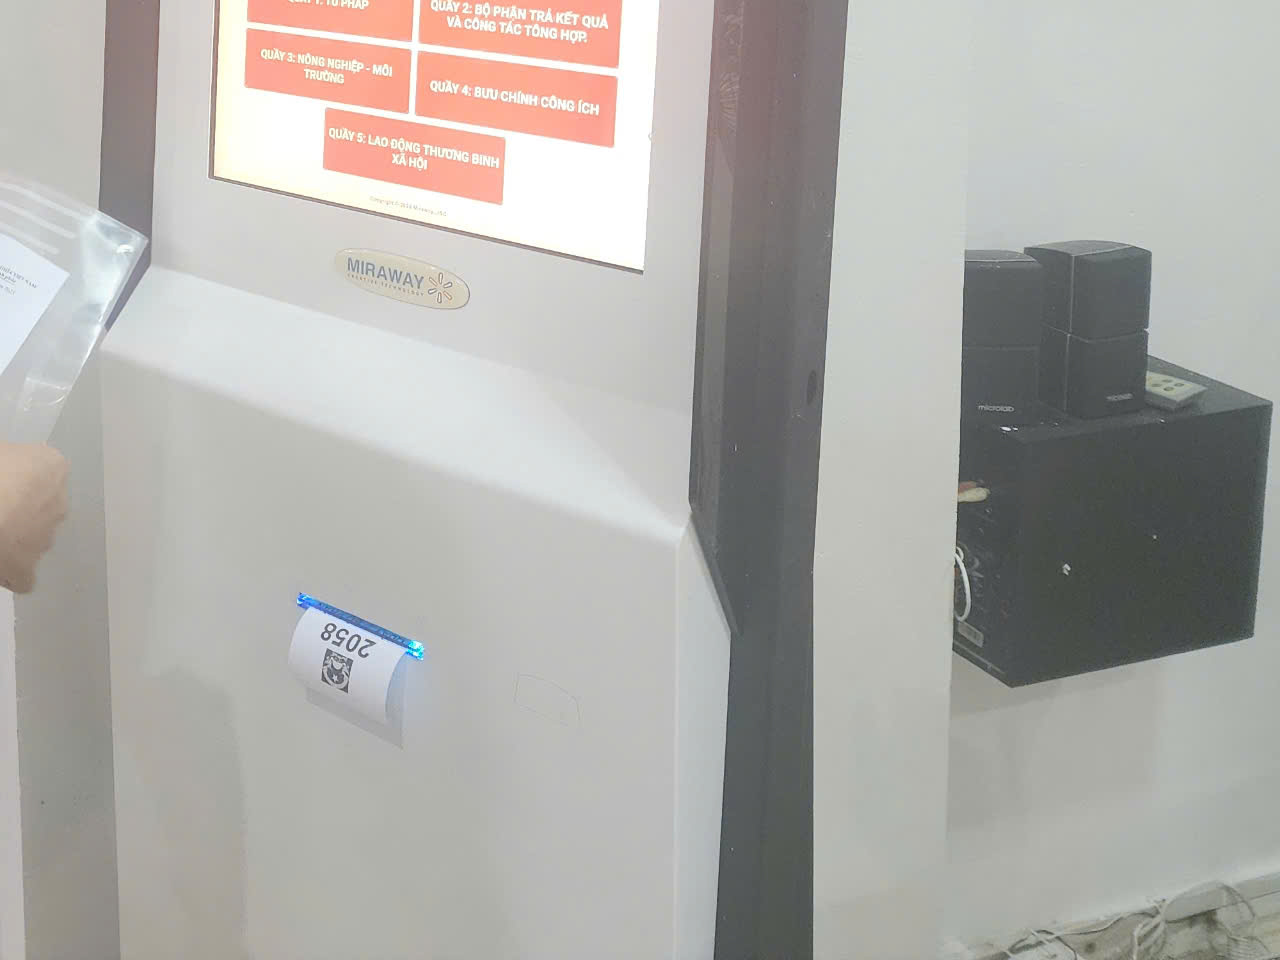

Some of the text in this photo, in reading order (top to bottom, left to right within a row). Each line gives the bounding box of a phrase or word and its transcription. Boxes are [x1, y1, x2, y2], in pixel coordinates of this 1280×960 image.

[446, 15, 462, 28] VÀ
[464, 16, 496, 32] CÔNG
[499, 20, 522, 35] TÁC
[462, 2, 472, 14] 2:
[475, 2, 491, 17] BỘ
[493, 5, 527, 22] PHẬN
[529, 8, 554, 23] TRẢ
[555, 11, 580, 26] KẾT
[582, 13, 609, 29] QUẢ
[287, 52, 296, 63] 3:
[297, 52, 325, 67] NÔNG
[327, 57, 364, 74] NGHIỆP
[372, 64, 393, 77] MÔI
[304, 68, 344, 84] TRƯỜNG
[461, 84, 472, 97] 4:
[474, 86, 498, 100] BƯU
[500, 89, 538, 107] CHÍNH
[540, 95, 575, 113] CÔNG
[578, 99, 600, 116] ÍCH
[357, 132, 367, 144] 5:
[368, 134, 389, 148] LAO
[390, 138, 420, 154] ĐỘNG
[423, 144, 470, 163] THƯƠNG
[471, 153, 500, 169] BINH
[392, 152, 428, 172] XÃ HỘI
[347, 257, 424, 290] MIRAWAY
[320, 622, 377, 659] 2058
